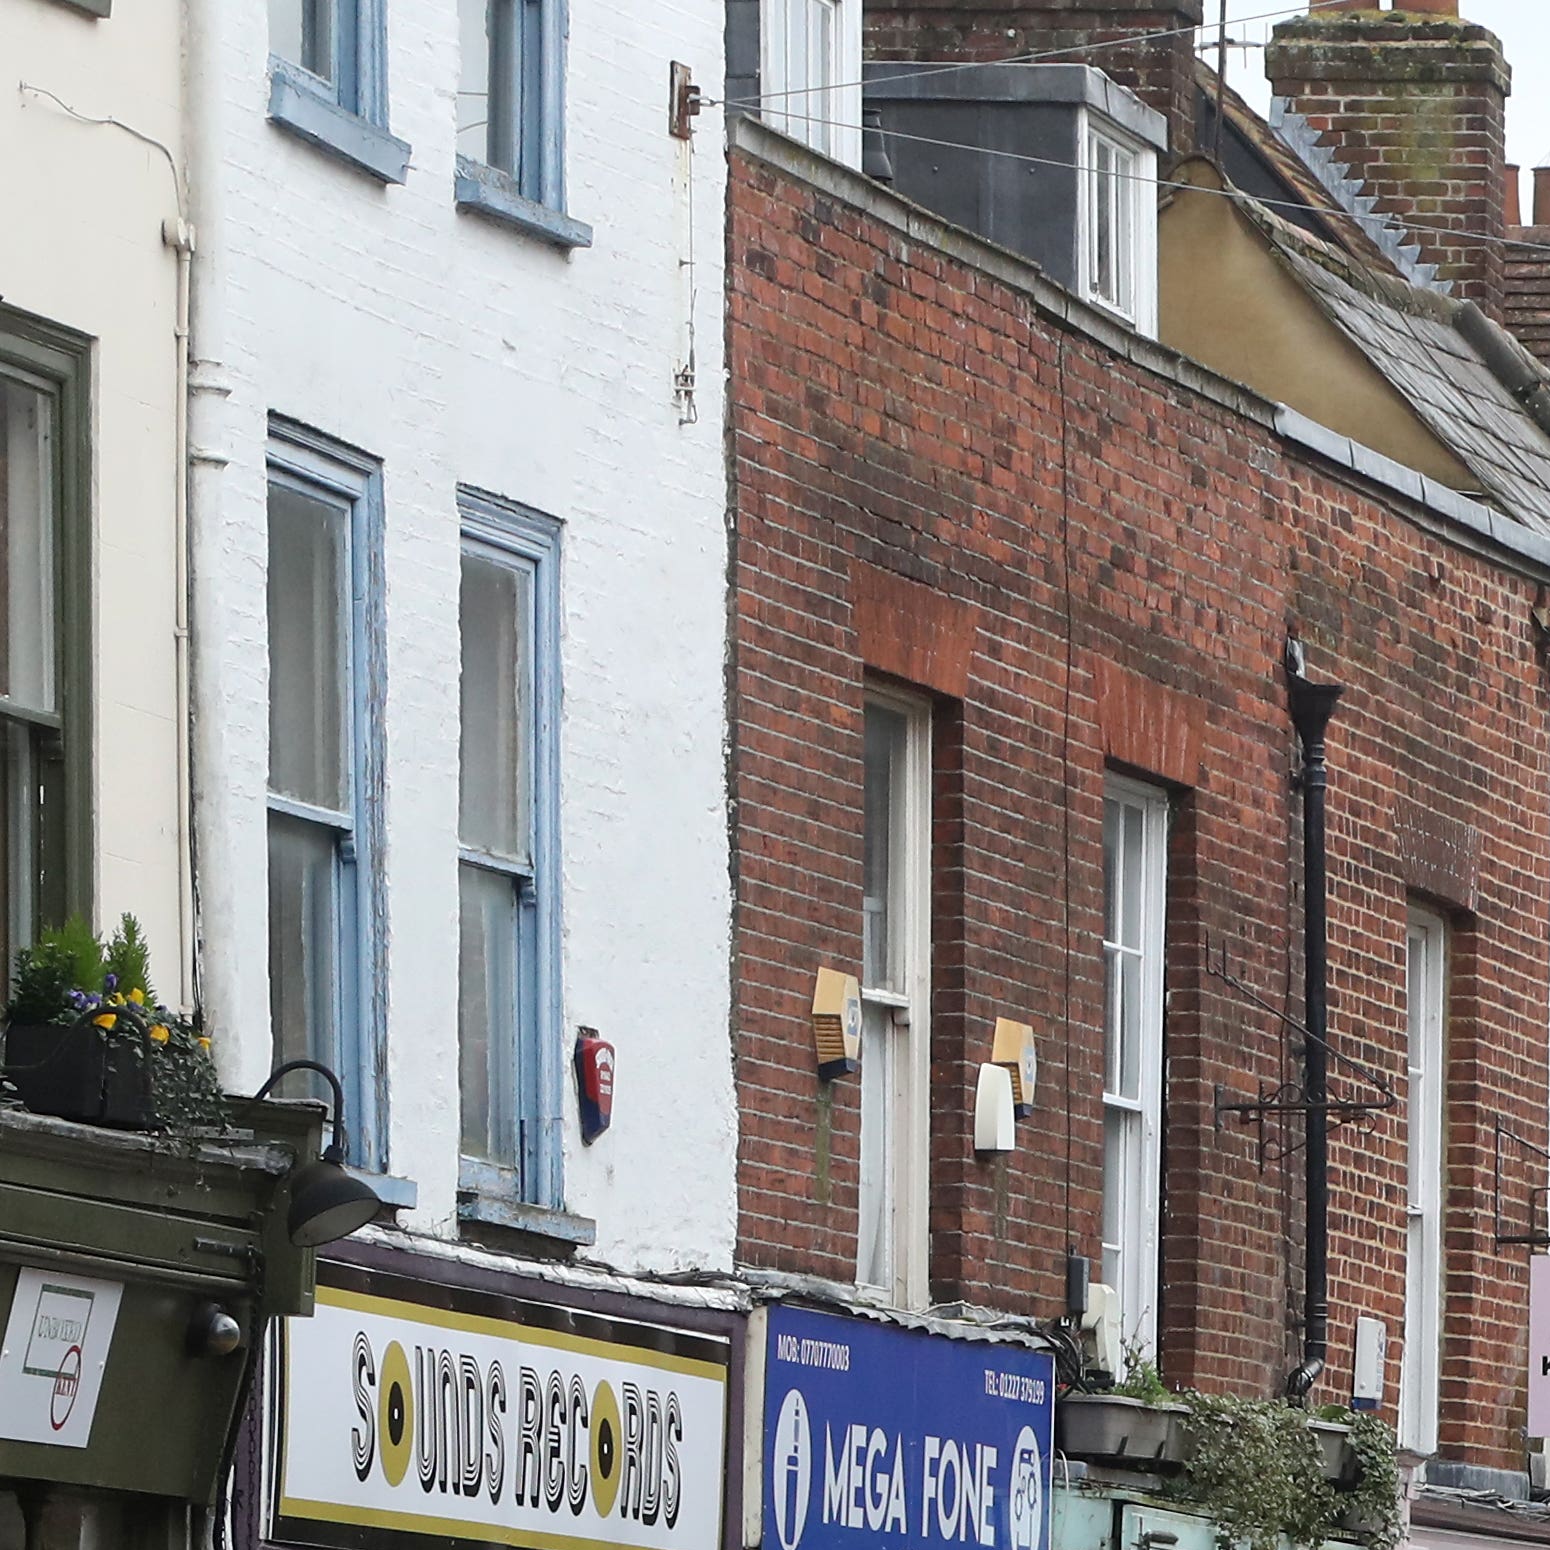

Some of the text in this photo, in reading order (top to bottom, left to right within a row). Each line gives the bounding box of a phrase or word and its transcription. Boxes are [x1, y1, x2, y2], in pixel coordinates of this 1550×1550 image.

[778, 1334, 800, 1361] MOB:
[985, 1369, 1000, 1396] TEL:
[352, 1331, 683, 1530] SOUNDS RECORDS
[823, 1420, 998, 1546] MEGA FONE
